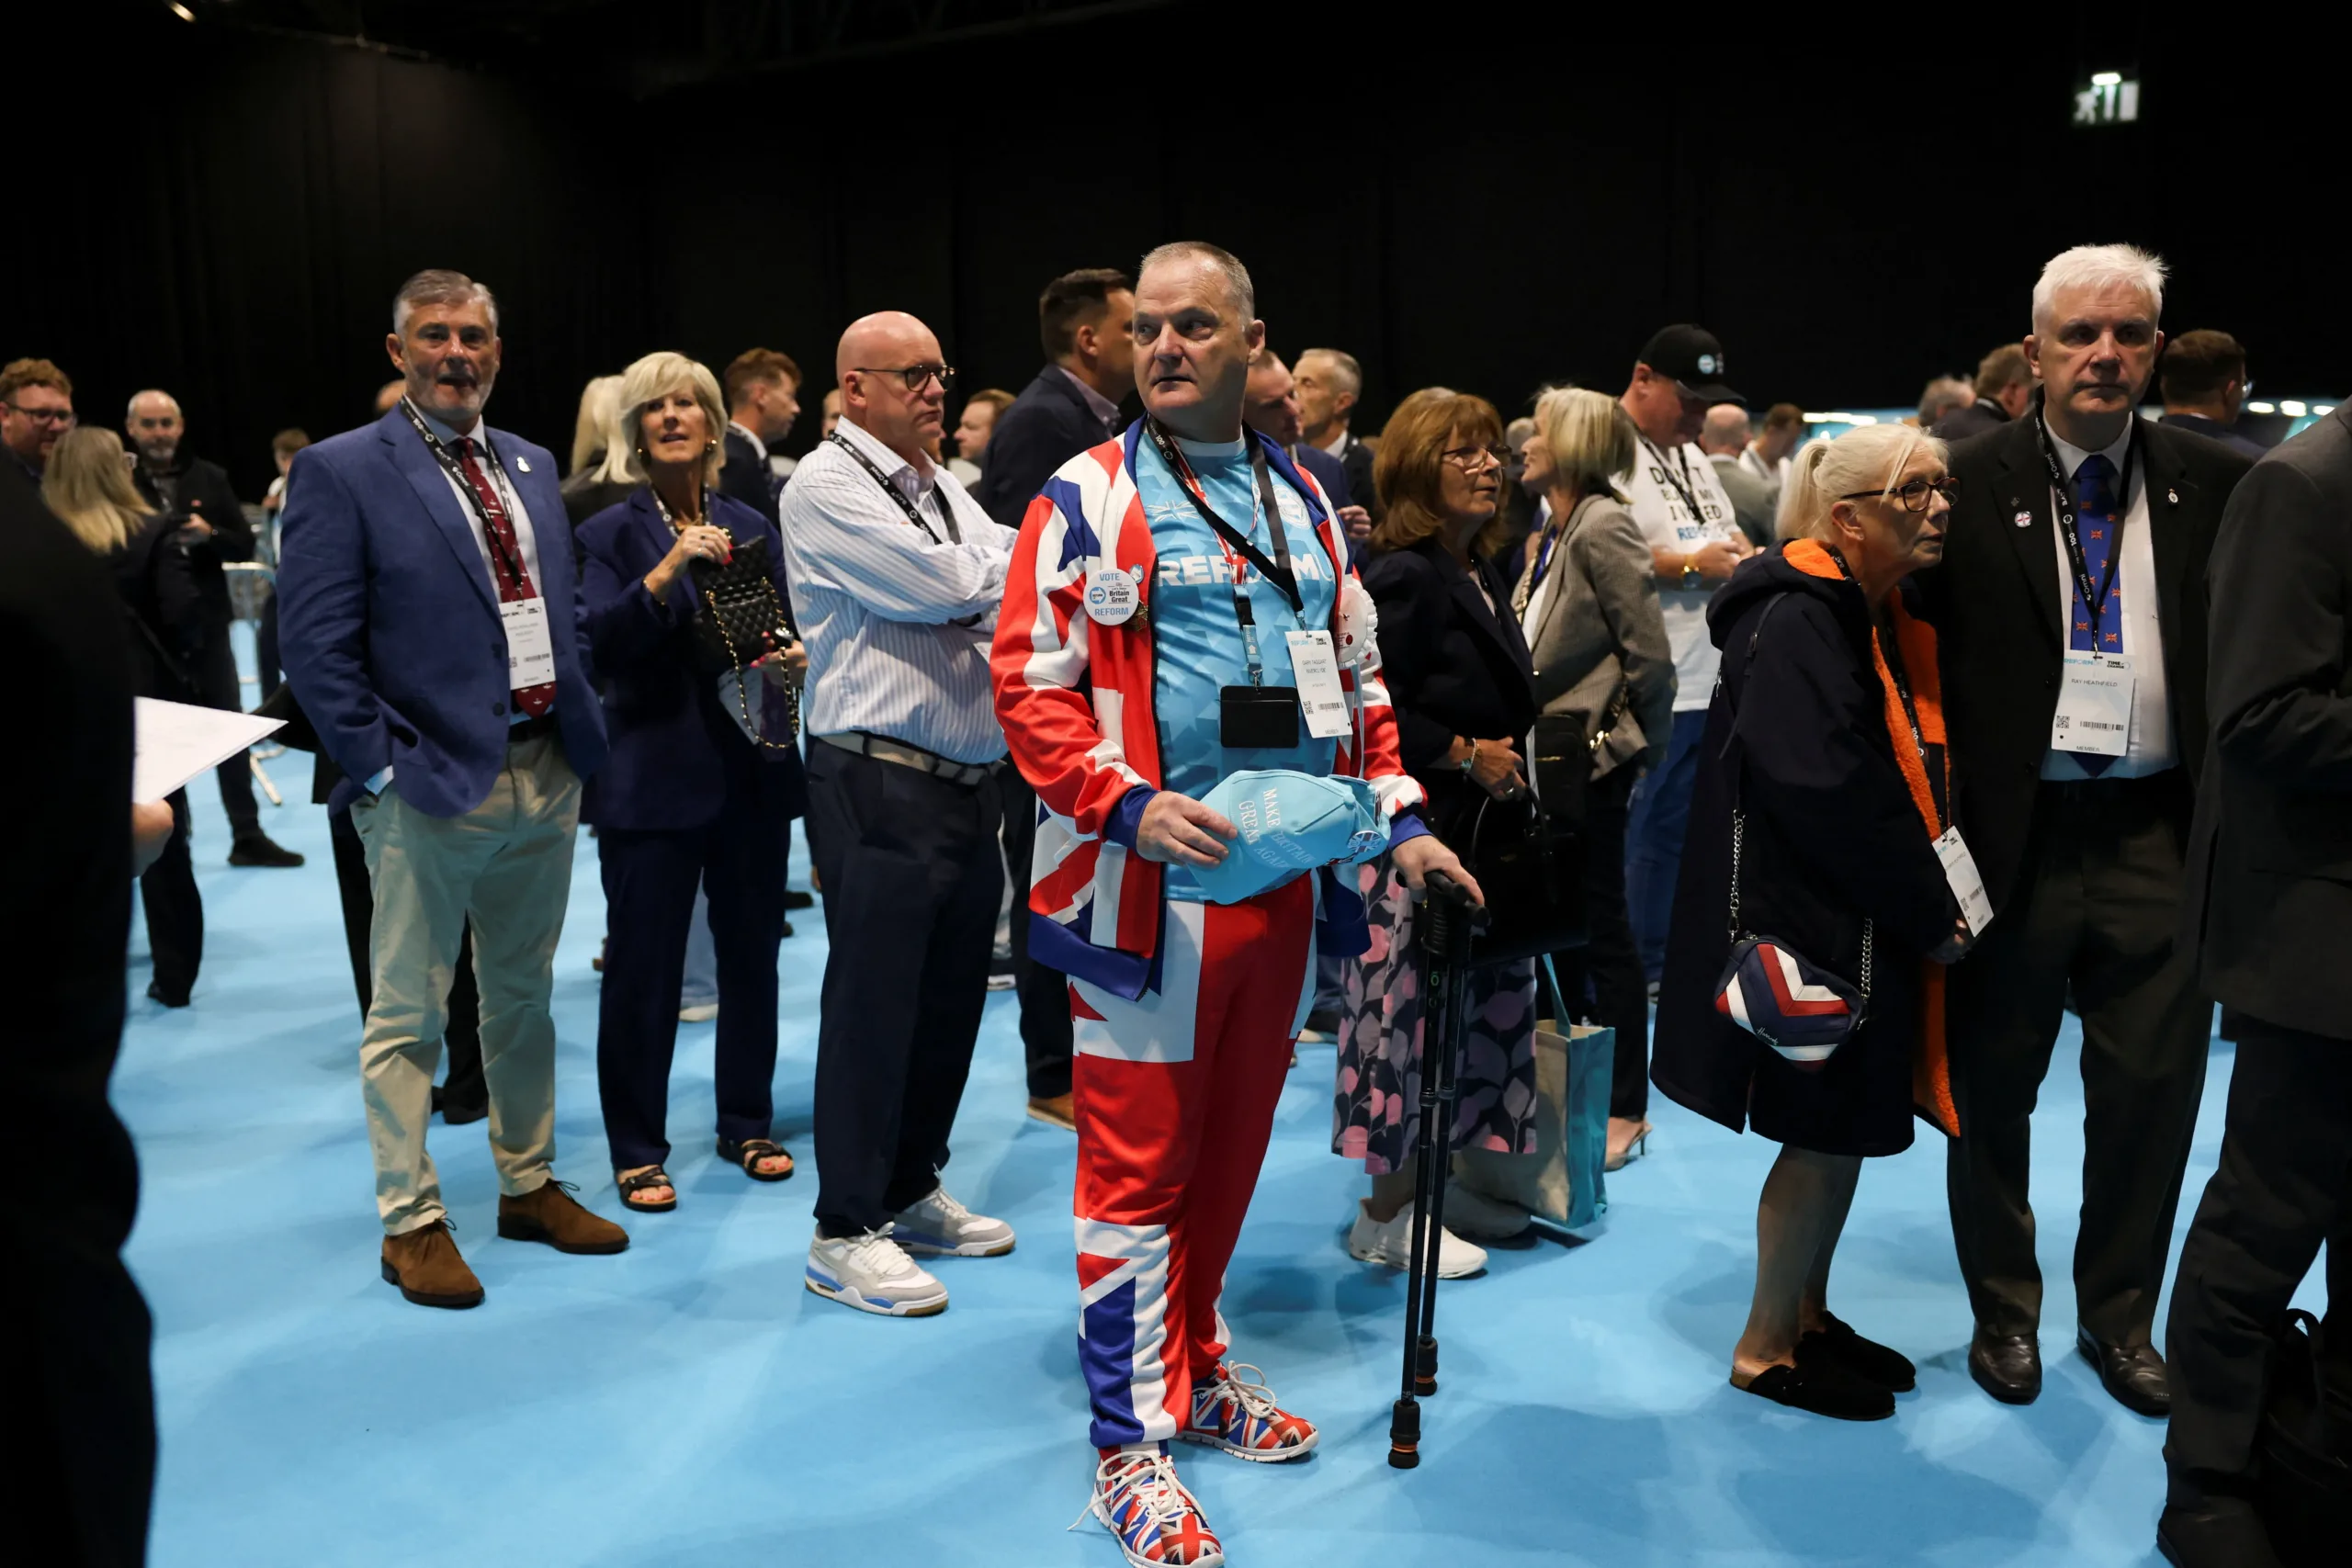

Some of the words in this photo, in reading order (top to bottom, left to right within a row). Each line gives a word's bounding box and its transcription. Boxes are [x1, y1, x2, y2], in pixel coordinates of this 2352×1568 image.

[1156, 434, 1165, 446] 100
[2044, 453, 2058, 472] Omni
[869, 466, 885, 481] Omni
[2078, 573, 2090, 594] Omni
[1094, 607, 1129, 616] REFORM
[1263, 787, 1280, 829] MAKE
[1271, 831, 1316, 863] BRITAIN
